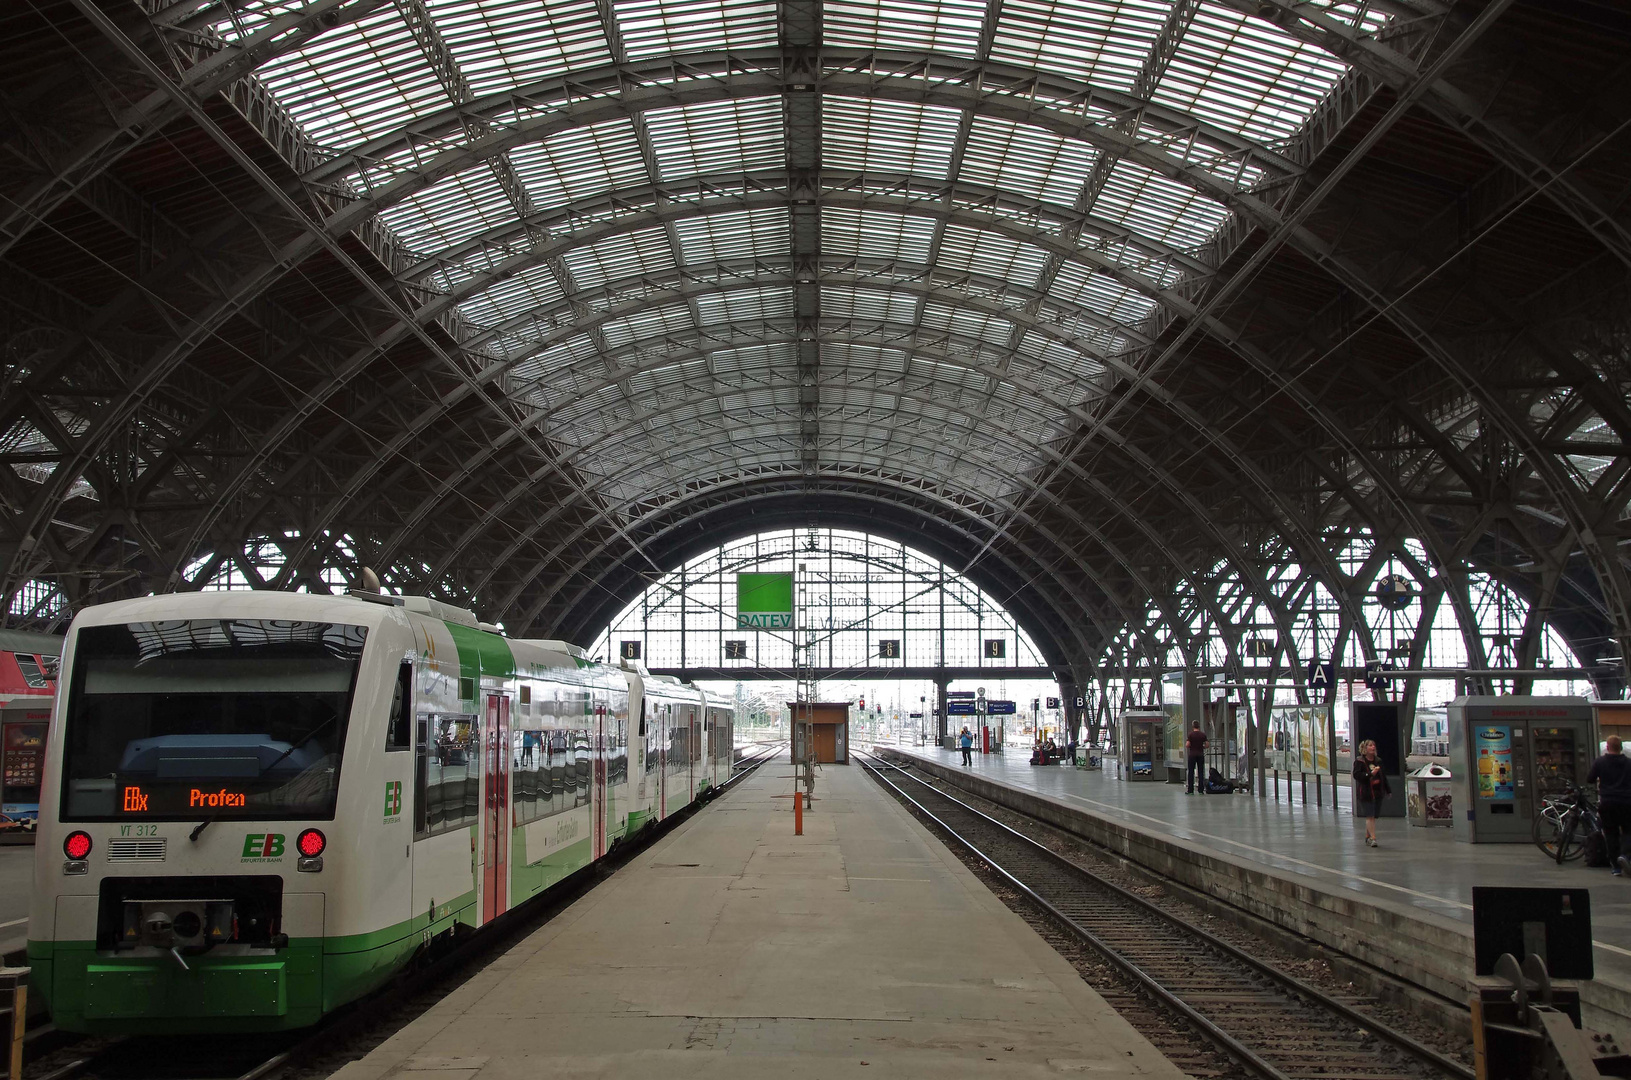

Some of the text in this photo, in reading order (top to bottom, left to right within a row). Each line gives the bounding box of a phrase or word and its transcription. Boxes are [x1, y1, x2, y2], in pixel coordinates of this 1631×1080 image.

[818, 594, 872, 606] Service
[738, 614, 792, 628] DATEV
[627, 642, 634, 658] 6
[733, 642, 739, 657] 7
[887, 641, 893, 657] 8
[992, 641, 998, 656] 9
[1312, 664, 1328, 684] A
[1047, 697, 1055, 707] B
[1076, 697, 1084, 707] B
[123, 786, 245, 811] EBx Profen
[384, 781, 402, 817] EB
[120, 825, 158, 836] VT 312
[241, 833, 286, 858] EB
